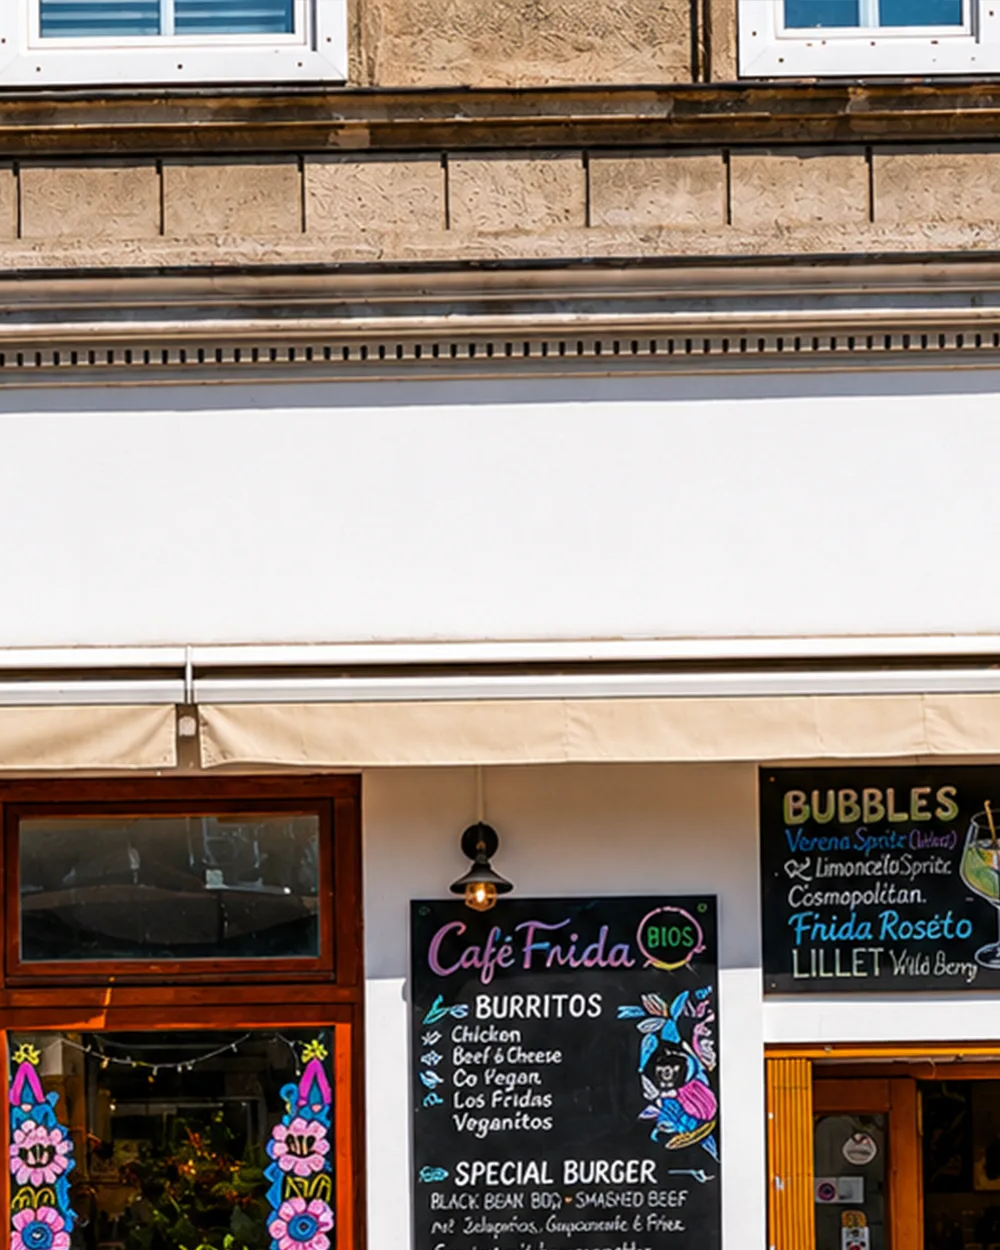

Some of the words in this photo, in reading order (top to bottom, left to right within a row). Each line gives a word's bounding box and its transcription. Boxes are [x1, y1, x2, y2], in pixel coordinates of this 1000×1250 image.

[783, 786, 959, 825] BUBBLES
[646, 925, 694, 948] BIOS
[788, 911, 873, 946] Frida
[428, 920, 516, 985] Café
[515, 918, 636, 970] Frida
[792, 948, 884, 979] LILLET
[889, 949, 931, 977] Wild
[932, 950, 978, 983] Berry
[475, 994, 603, 1019] BURRITOS
[451, 1024, 521, 1044] Chicken
[452, 1045, 492, 1066] Beef
[506, 1045, 563, 1064] Cheese
[453, 1091, 486, 1109] Los
[491, 1088, 553, 1108] Fridas
[452, 1111, 553, 1139] Veganitos
[454, 1161, 553, 1186] SPECIAL
[563, 1160, 657, 1185] BURGER
[647, 1189, 689, 1207] BEEF
